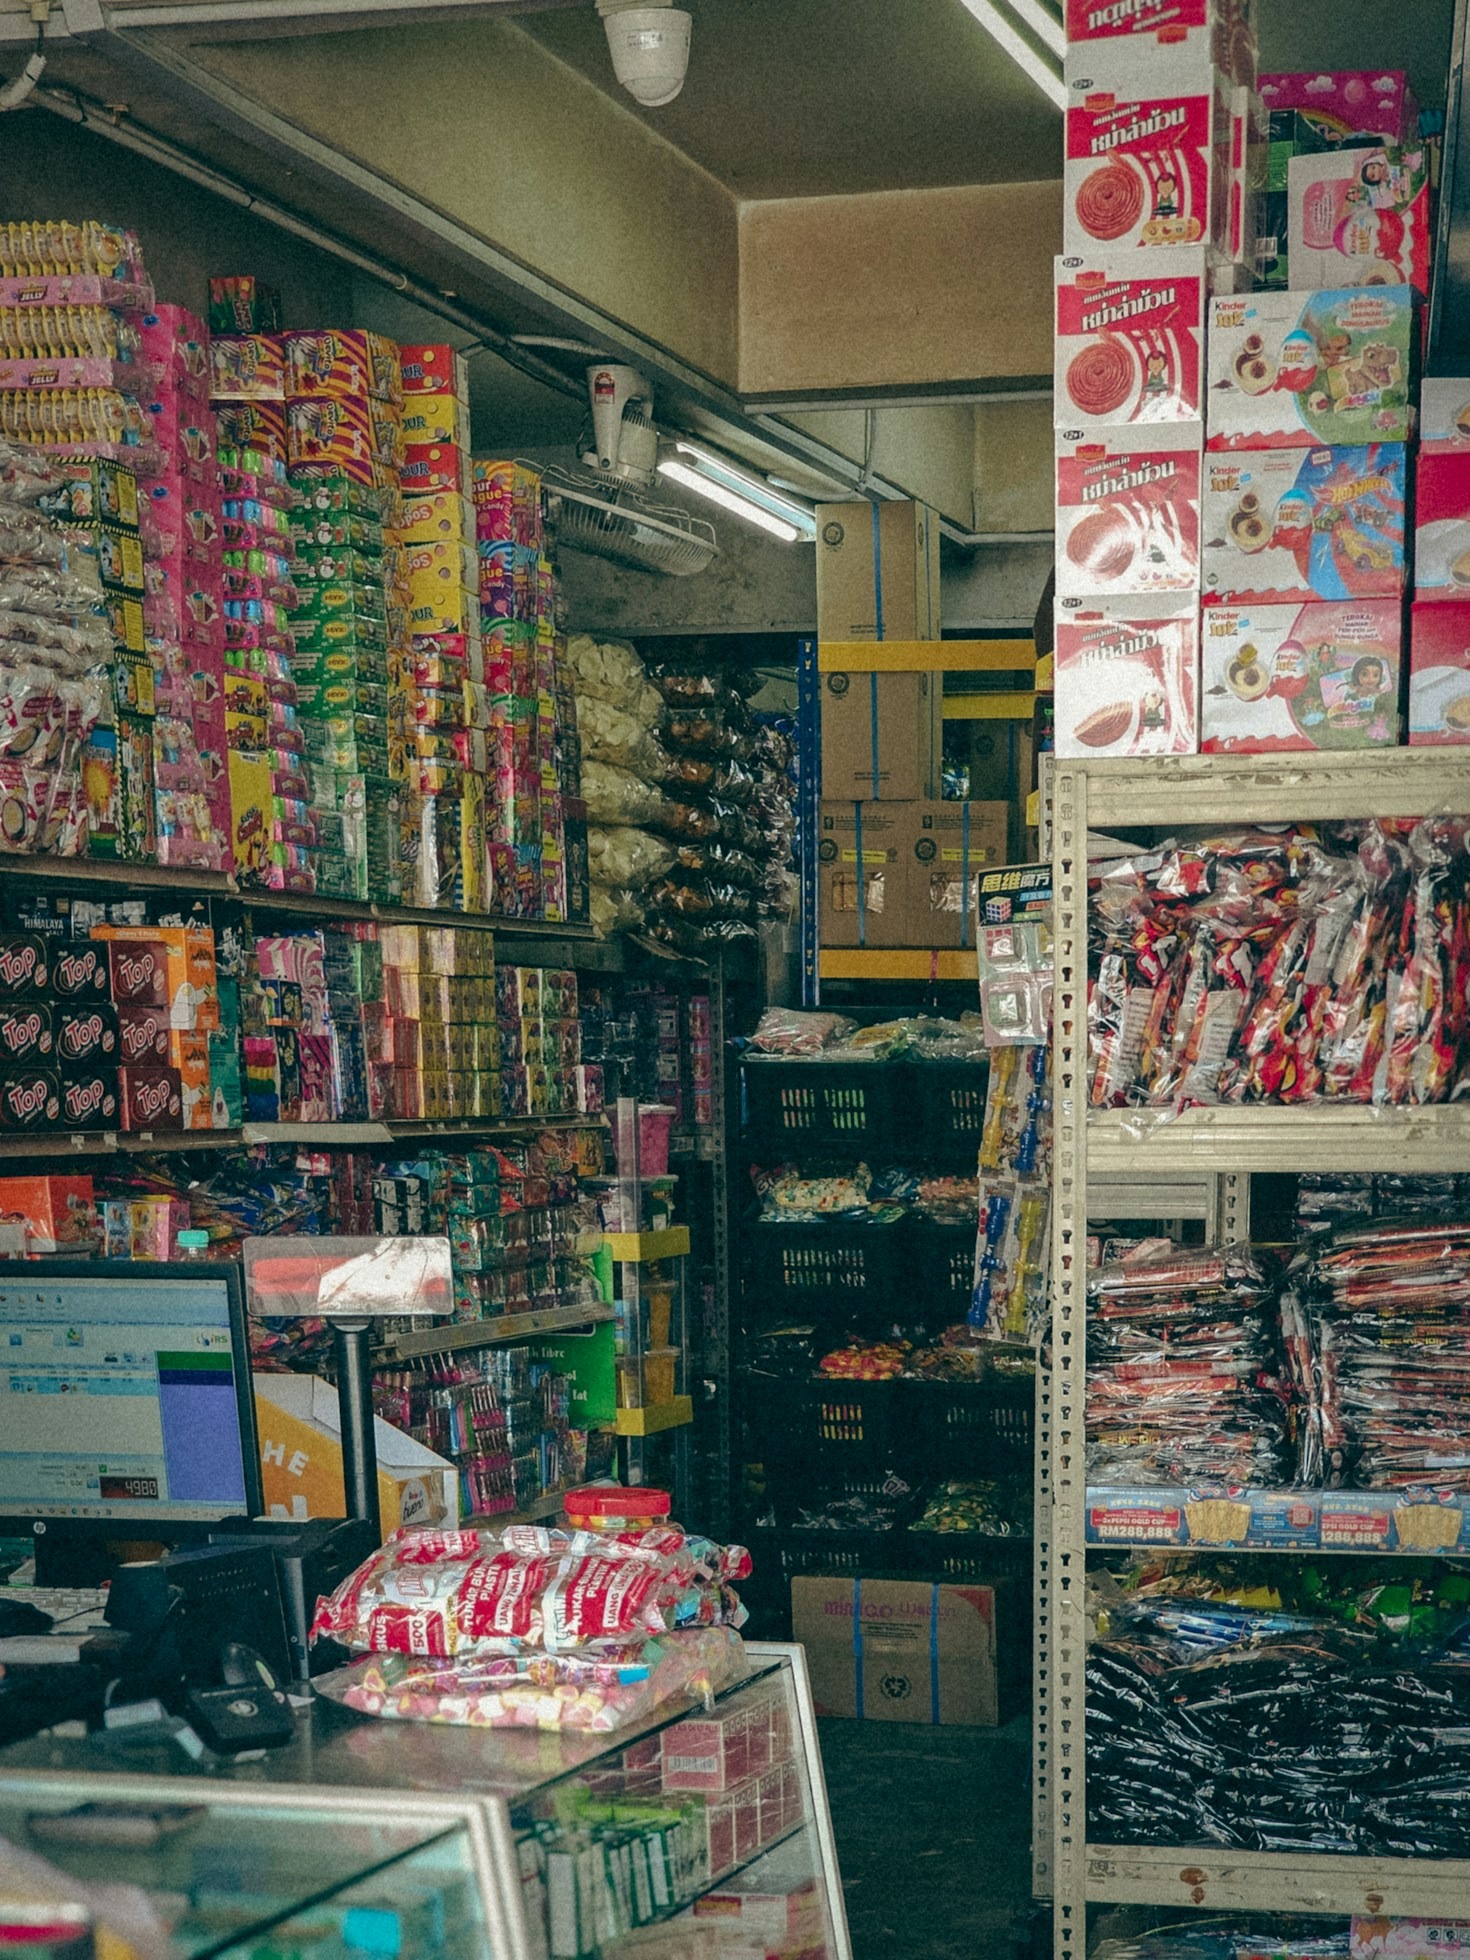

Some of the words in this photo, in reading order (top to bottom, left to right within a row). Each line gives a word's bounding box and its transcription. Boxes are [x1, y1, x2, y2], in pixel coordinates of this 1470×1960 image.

[1090, 106, 1186, 155] หม่าล่าม้วน
[20, 292, 44, 302] JELLY
[1081, 288, 1176, 332] หม่าล่าม้วน
[1215, 301, 1247, 311] Kinder
[31, 376, 56, 385] JELLY
[1210, 465, 1241, 475] Kinder
[1081, 460, 1176, 502] หม่าล่าม้วน
[1332, 484, 1351, 503] HOT
[1208, 611, 1240, 620] Kinder
[981, 871, 1050, 893] 思维魔方
[24, 917, 64, 930] HIMALAYA
[210, 1334, 228, 1344] iRS
[403, 1498, 425, 1521] bueno
[34, 1523, 45, 1535] hp
[1151, 1518, 1166, 1526] CUP
[1098, 1525, 1173, 1540] RM288,888
[607, 1593, 619, 1624] UANG
[412, 1619, 425, 1648] 500
